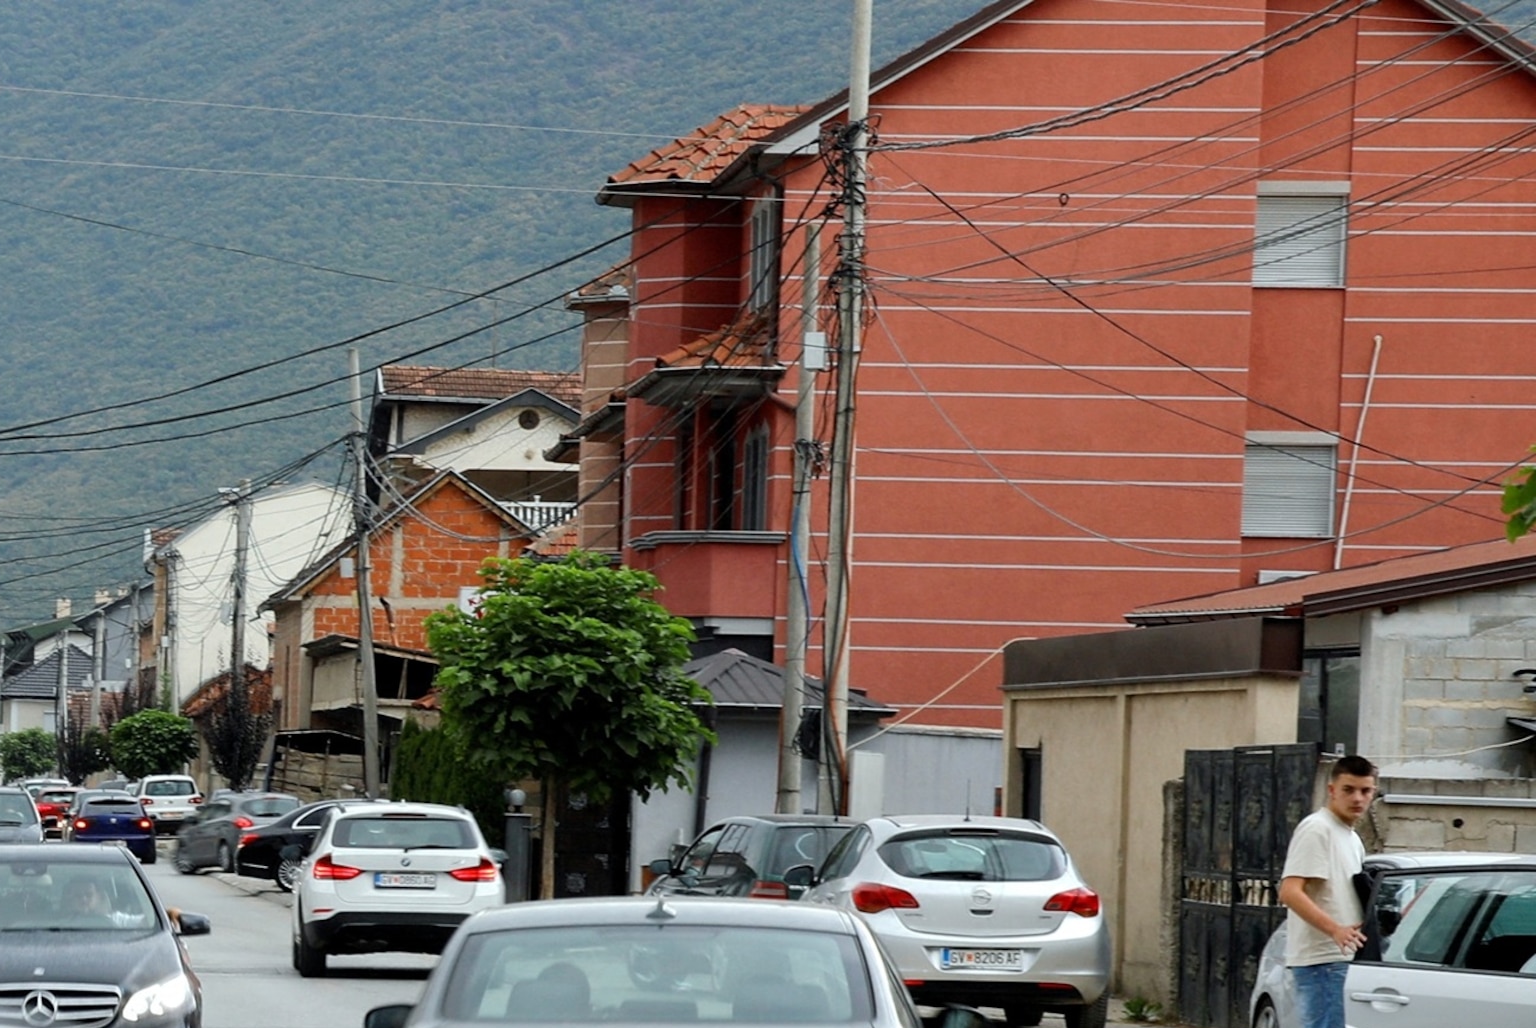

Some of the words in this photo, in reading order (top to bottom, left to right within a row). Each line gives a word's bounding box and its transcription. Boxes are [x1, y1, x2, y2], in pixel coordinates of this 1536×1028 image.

[951, 952, 965, 964] GV
[974, 952, 1005, 964] 8206
[1006, 952, 1021, 965] AF
